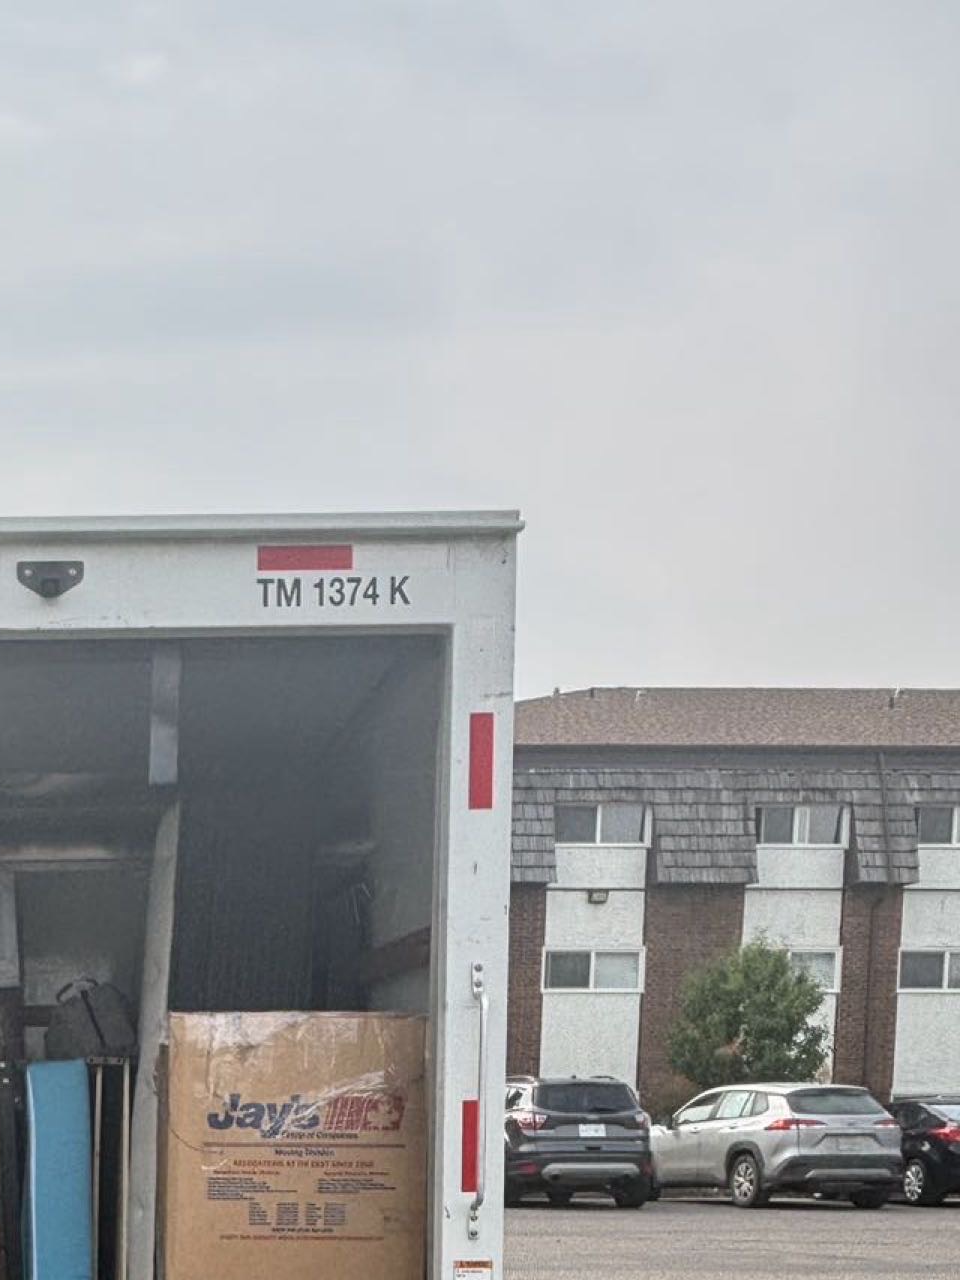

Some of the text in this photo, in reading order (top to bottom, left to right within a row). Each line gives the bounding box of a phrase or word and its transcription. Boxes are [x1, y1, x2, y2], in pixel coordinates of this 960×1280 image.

[256, 575, 411, 608] TM 1374 K
[207, 1093, 320, 1139] Jay's
